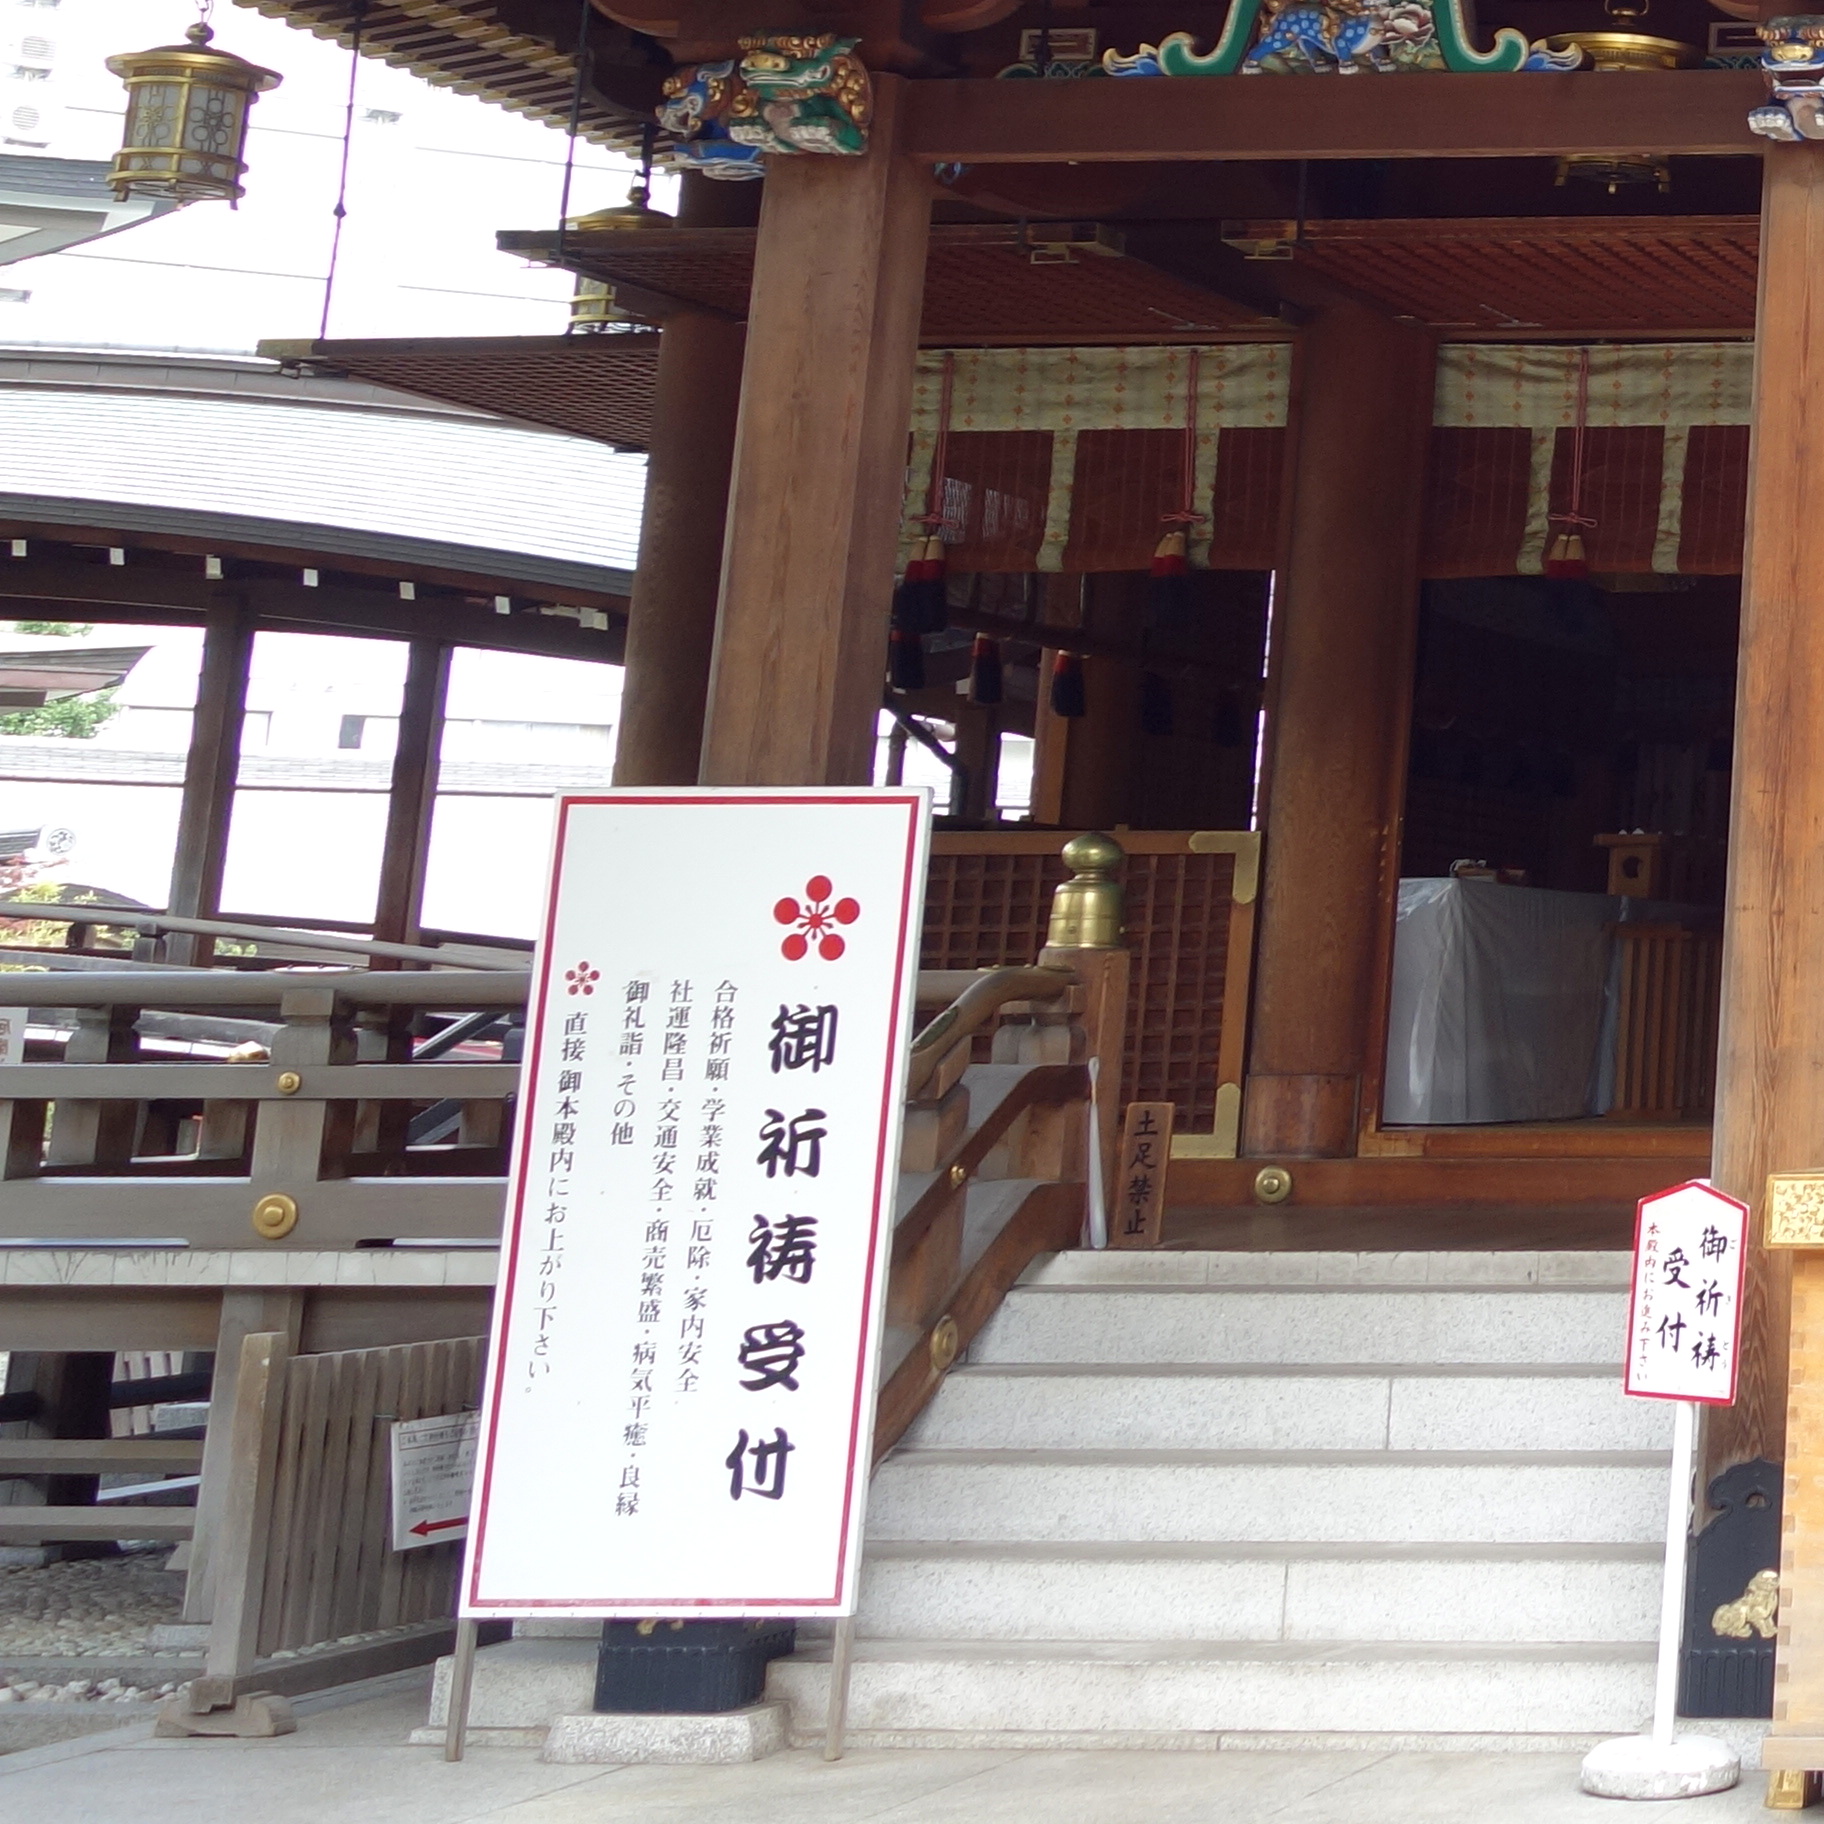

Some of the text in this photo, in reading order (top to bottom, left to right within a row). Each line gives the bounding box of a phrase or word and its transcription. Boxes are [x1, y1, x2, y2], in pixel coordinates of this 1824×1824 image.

[610, 979, 650, 1147] 御礼詣・その他
[614, 979, 695, 1517] 社運隆昌・交通安全・商売繁盛・病気平癒・良縁
[674, 979, 739, 1394] 合格祈願・学業成就・厄除・家内安全
[725, 1003, 839, 1501] 御祈祷受付
[1123, 1110, 1158, 1235] 土足禁止
[1636, 1222, 1661, 1380] 本殿内にお進み下さい
[1655, 1246, 1691, 1353] 受付
[1690, 1224, 1728, 1372] 御祈祷
